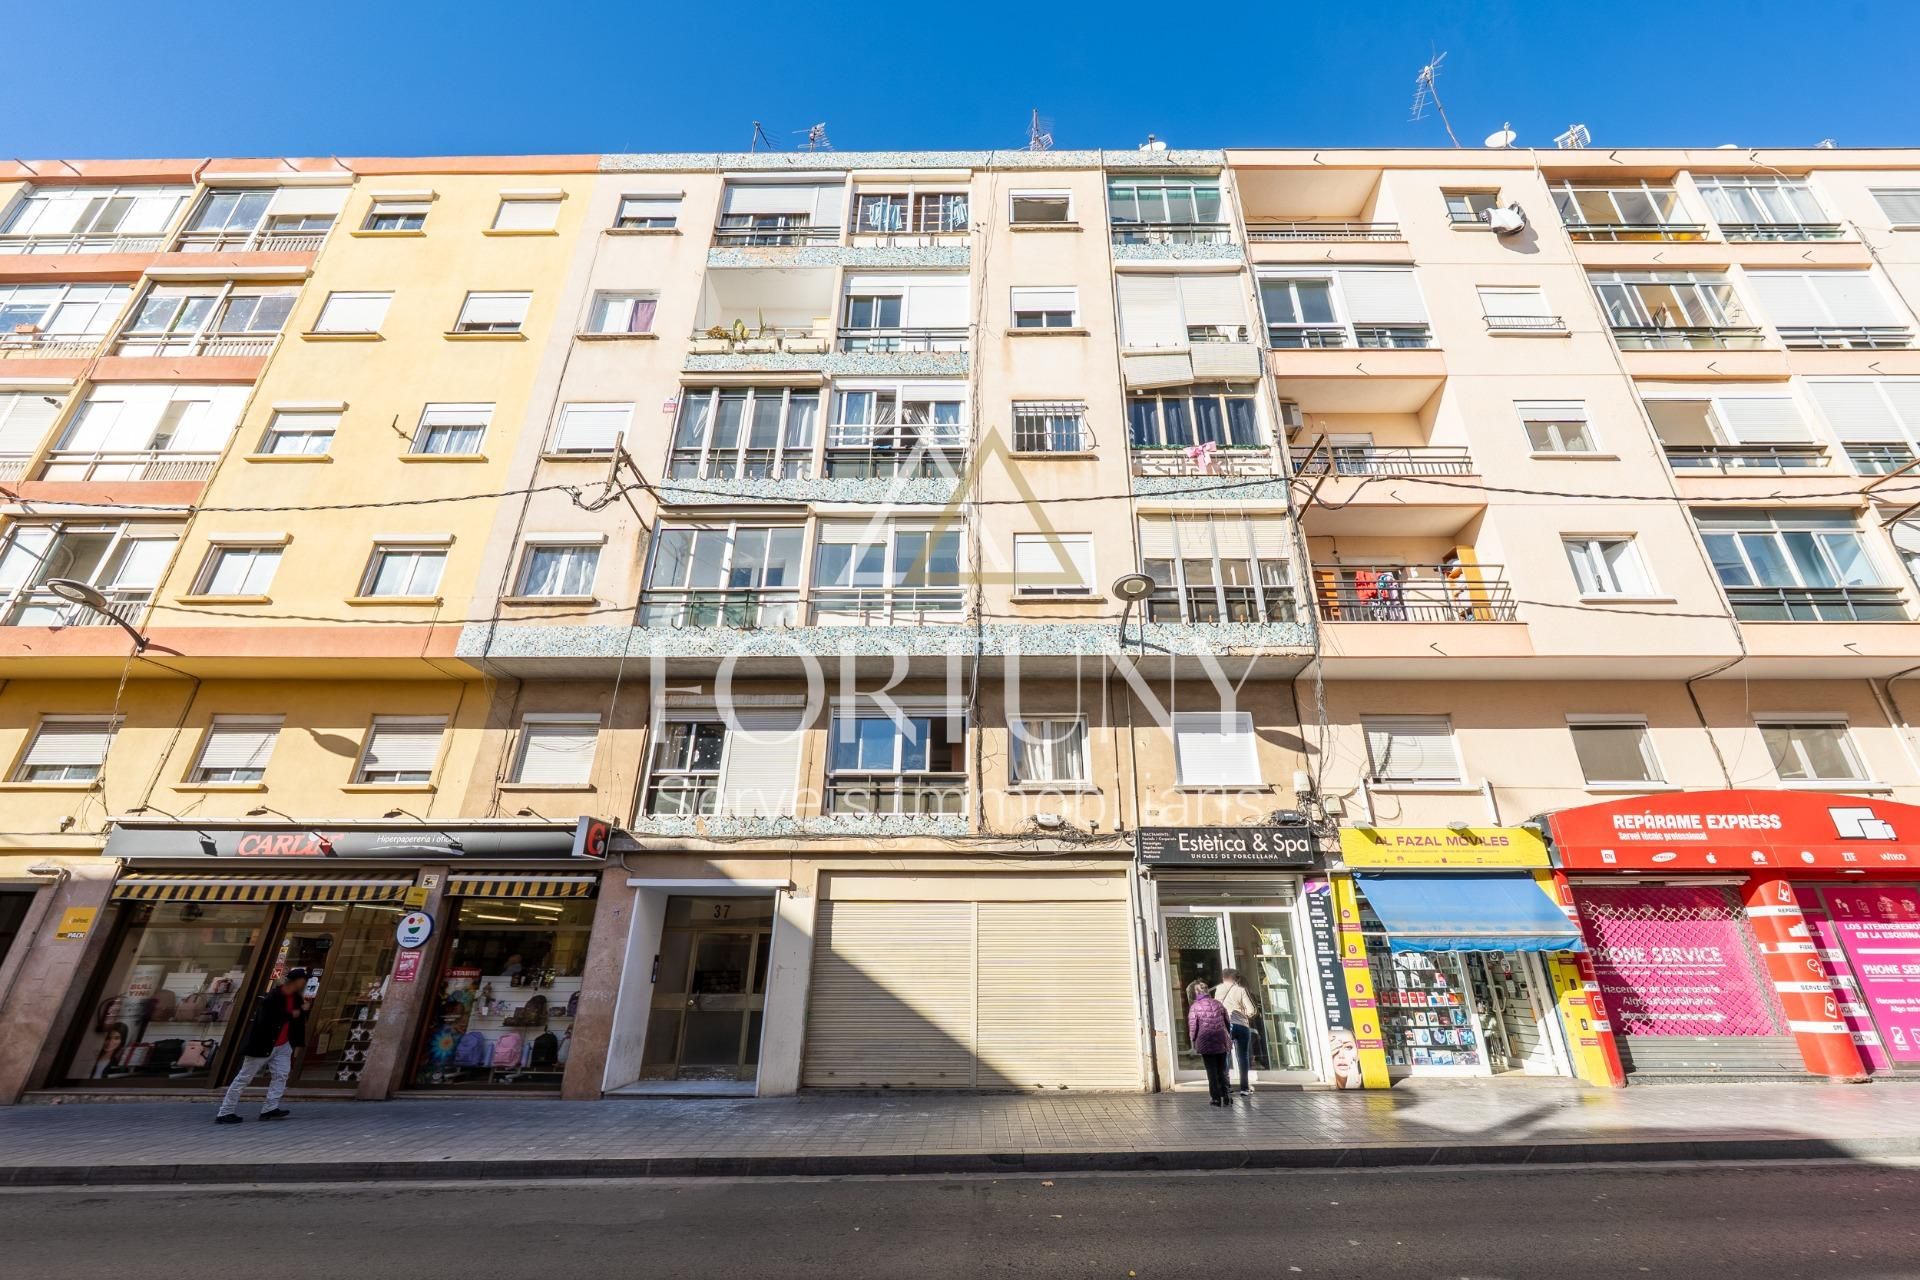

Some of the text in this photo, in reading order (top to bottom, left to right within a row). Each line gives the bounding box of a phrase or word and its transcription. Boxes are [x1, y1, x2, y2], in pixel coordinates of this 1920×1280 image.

[1612, 810, 1782, 830] REPÁRAME EXPRESS
[1178, 833, 1310, 858] Estètica & Spa
[1374, 834, 1510, 847] AL FAZAL MÓVILES
[713, 904, 731, 919] 37
[1651, 946, 1723, 962] SERVICE
[1862, 964, 1900, 975] PHONE
